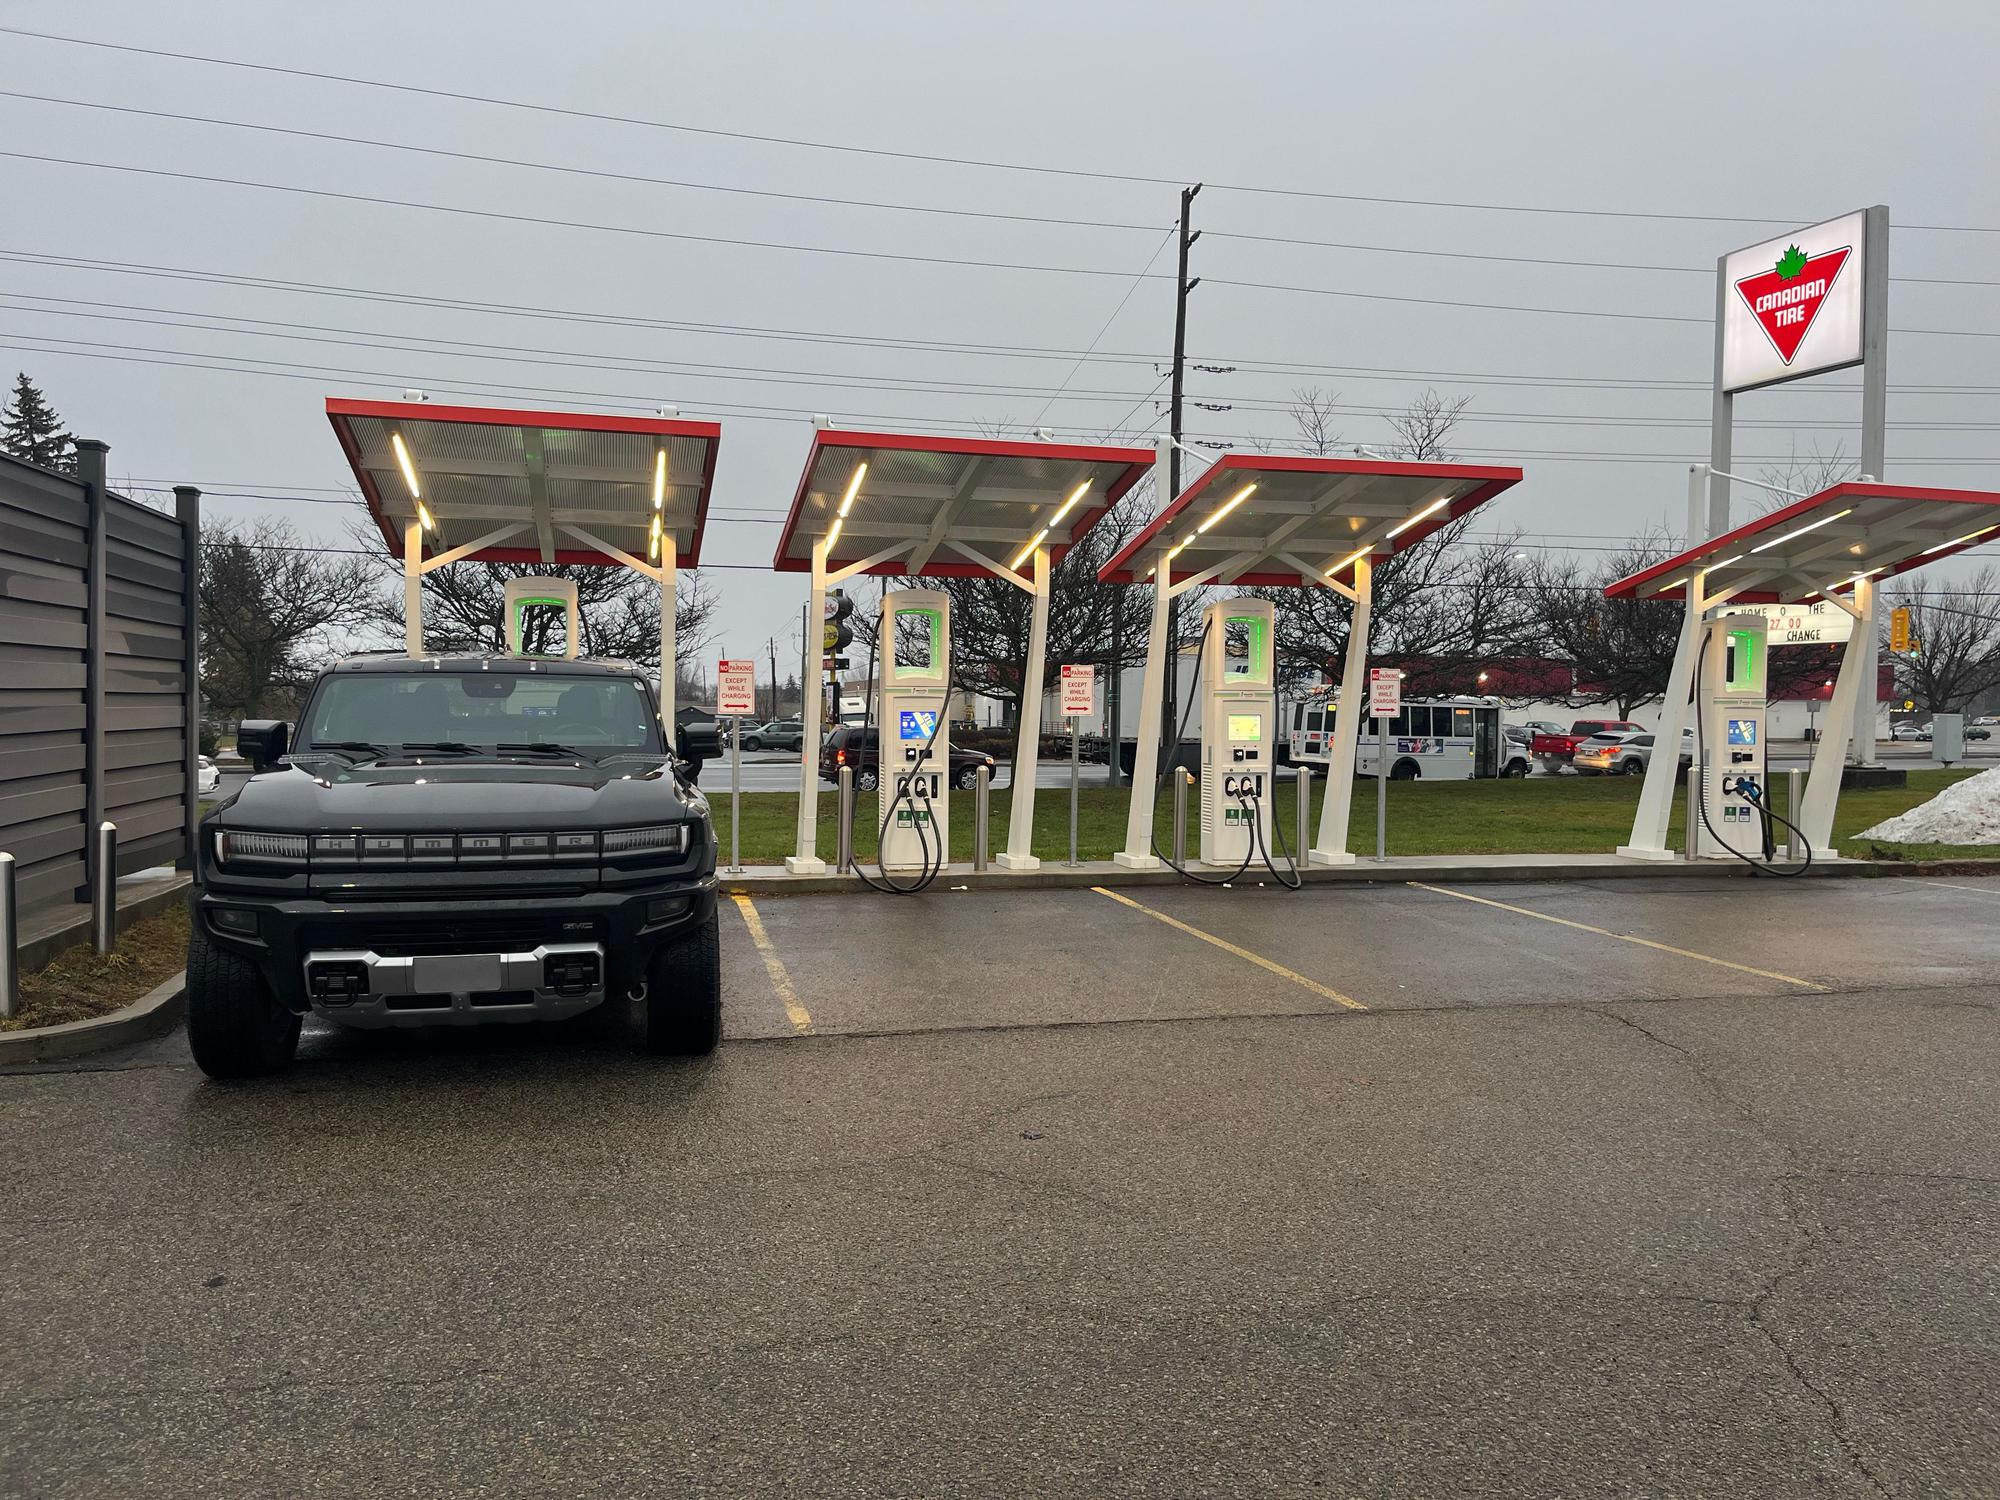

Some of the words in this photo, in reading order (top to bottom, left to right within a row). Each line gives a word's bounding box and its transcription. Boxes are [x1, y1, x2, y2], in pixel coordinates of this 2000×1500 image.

[1756, 278, 1825, 313] CANADIAN
[1775, 305, 1805, 328] TIRE
[1808, 604, 1825, 615] THE
[1786, 629, 1821, 641] CHANGE
[562, 922, 593, 930] GMC
